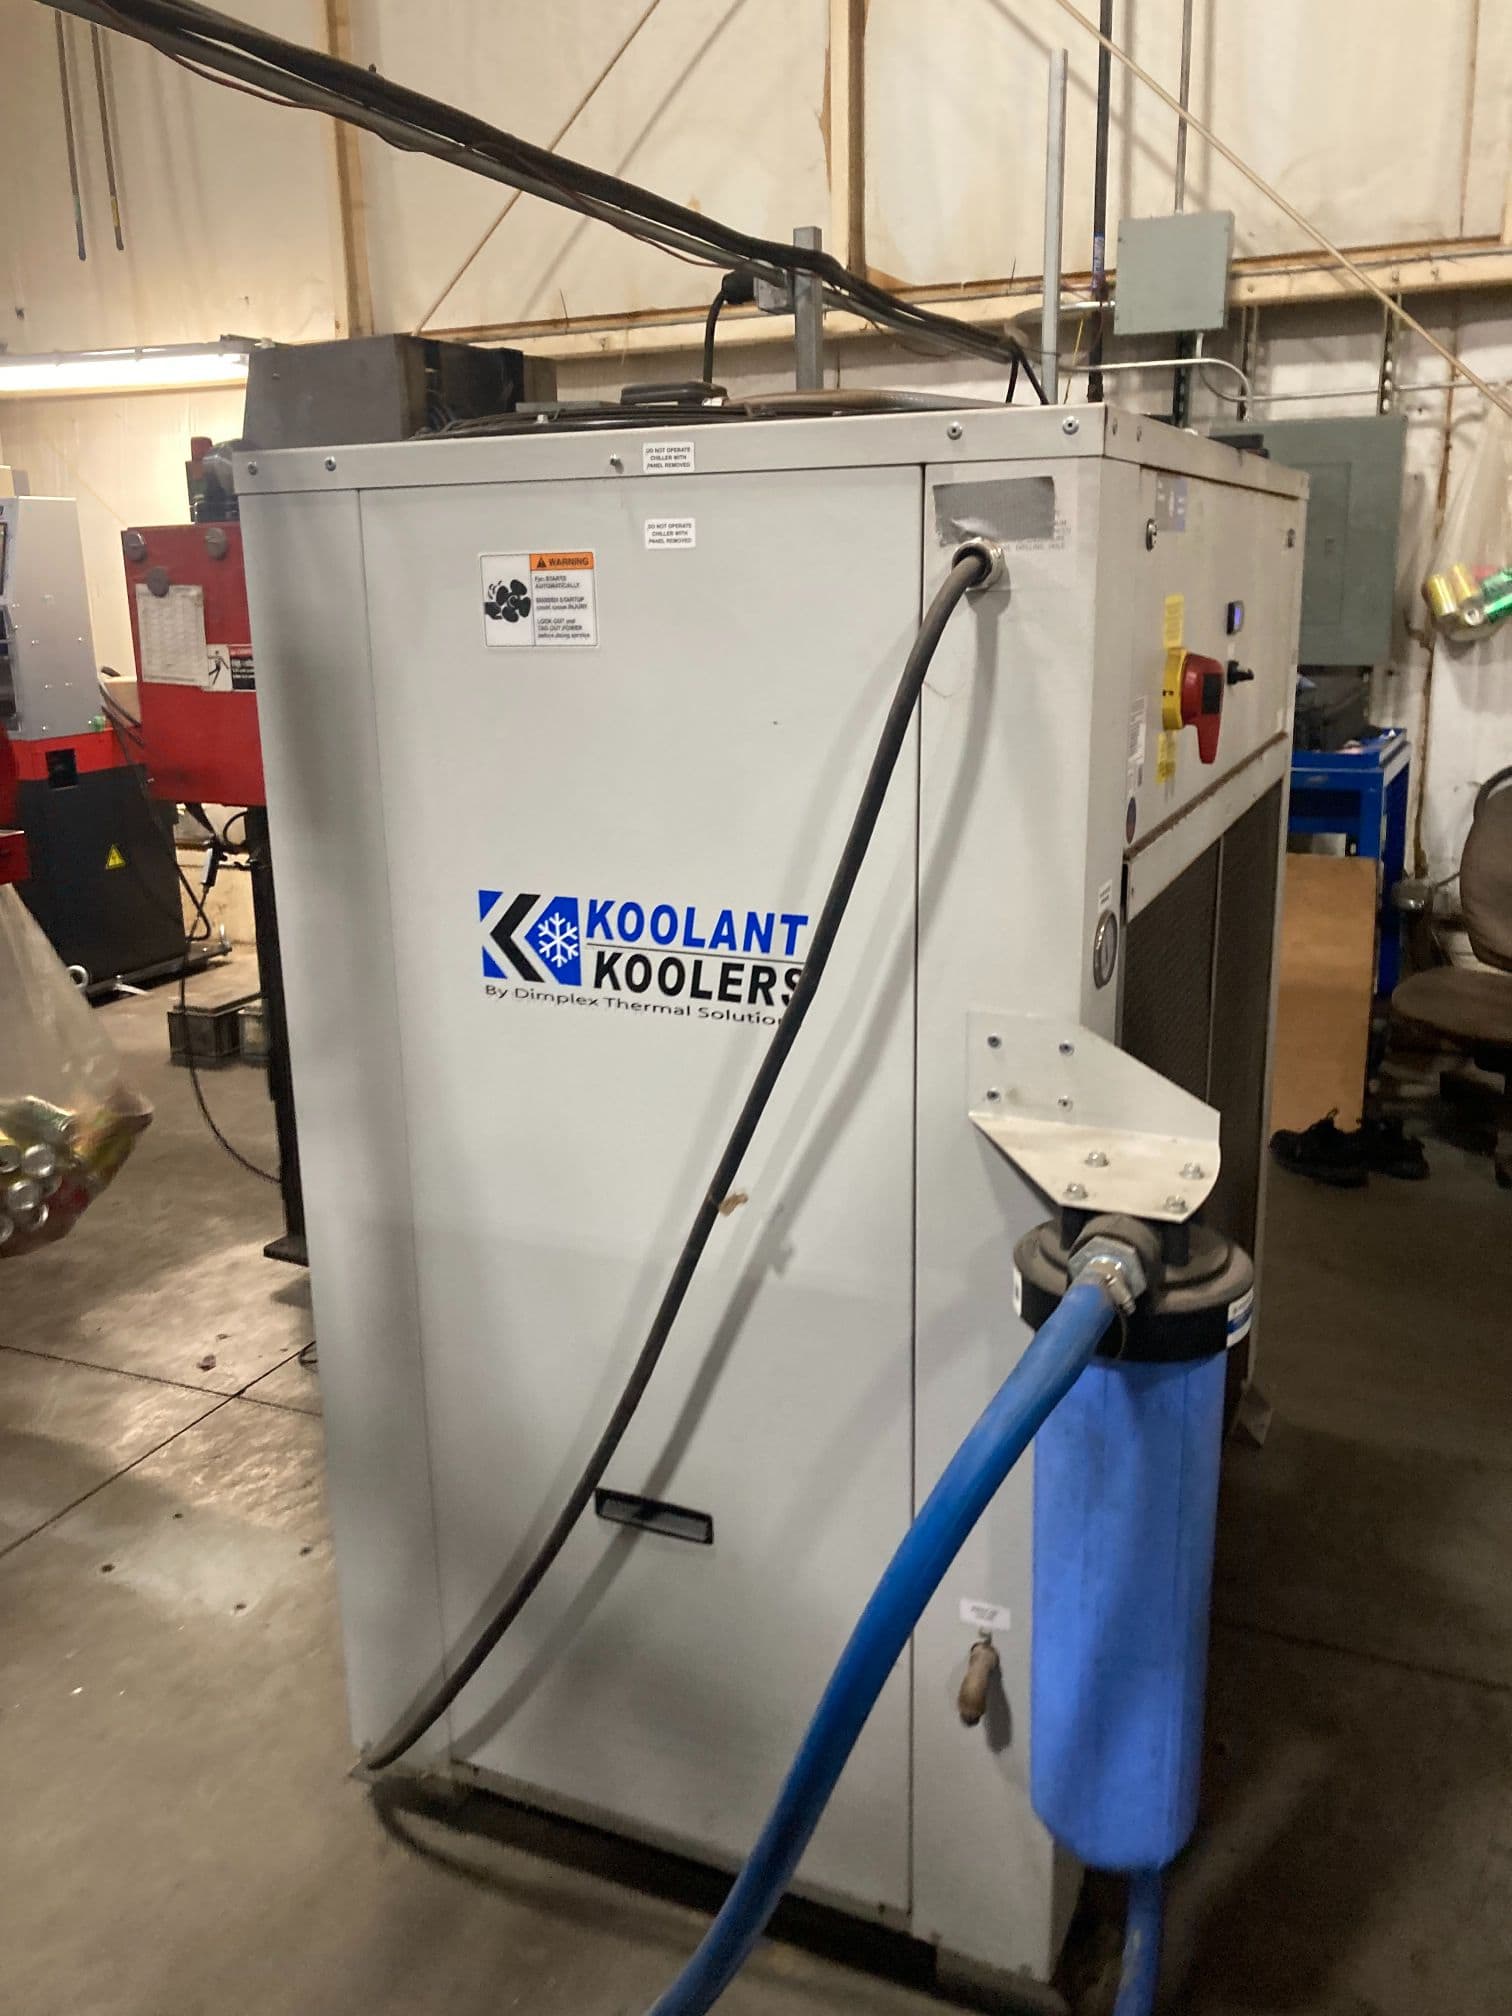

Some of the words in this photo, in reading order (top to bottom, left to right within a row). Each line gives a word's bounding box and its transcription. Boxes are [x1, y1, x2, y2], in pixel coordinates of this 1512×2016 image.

[548, 556, 589, 567] WARNING
[586, 898, 809, 957] KOOLANT
[485, 984, 508, 999] By
[514, 987, 600, 1007] Dimplex
[603, 996, 691, 1017] Thermal
[697, 1006, 784, 1026] Solutio
